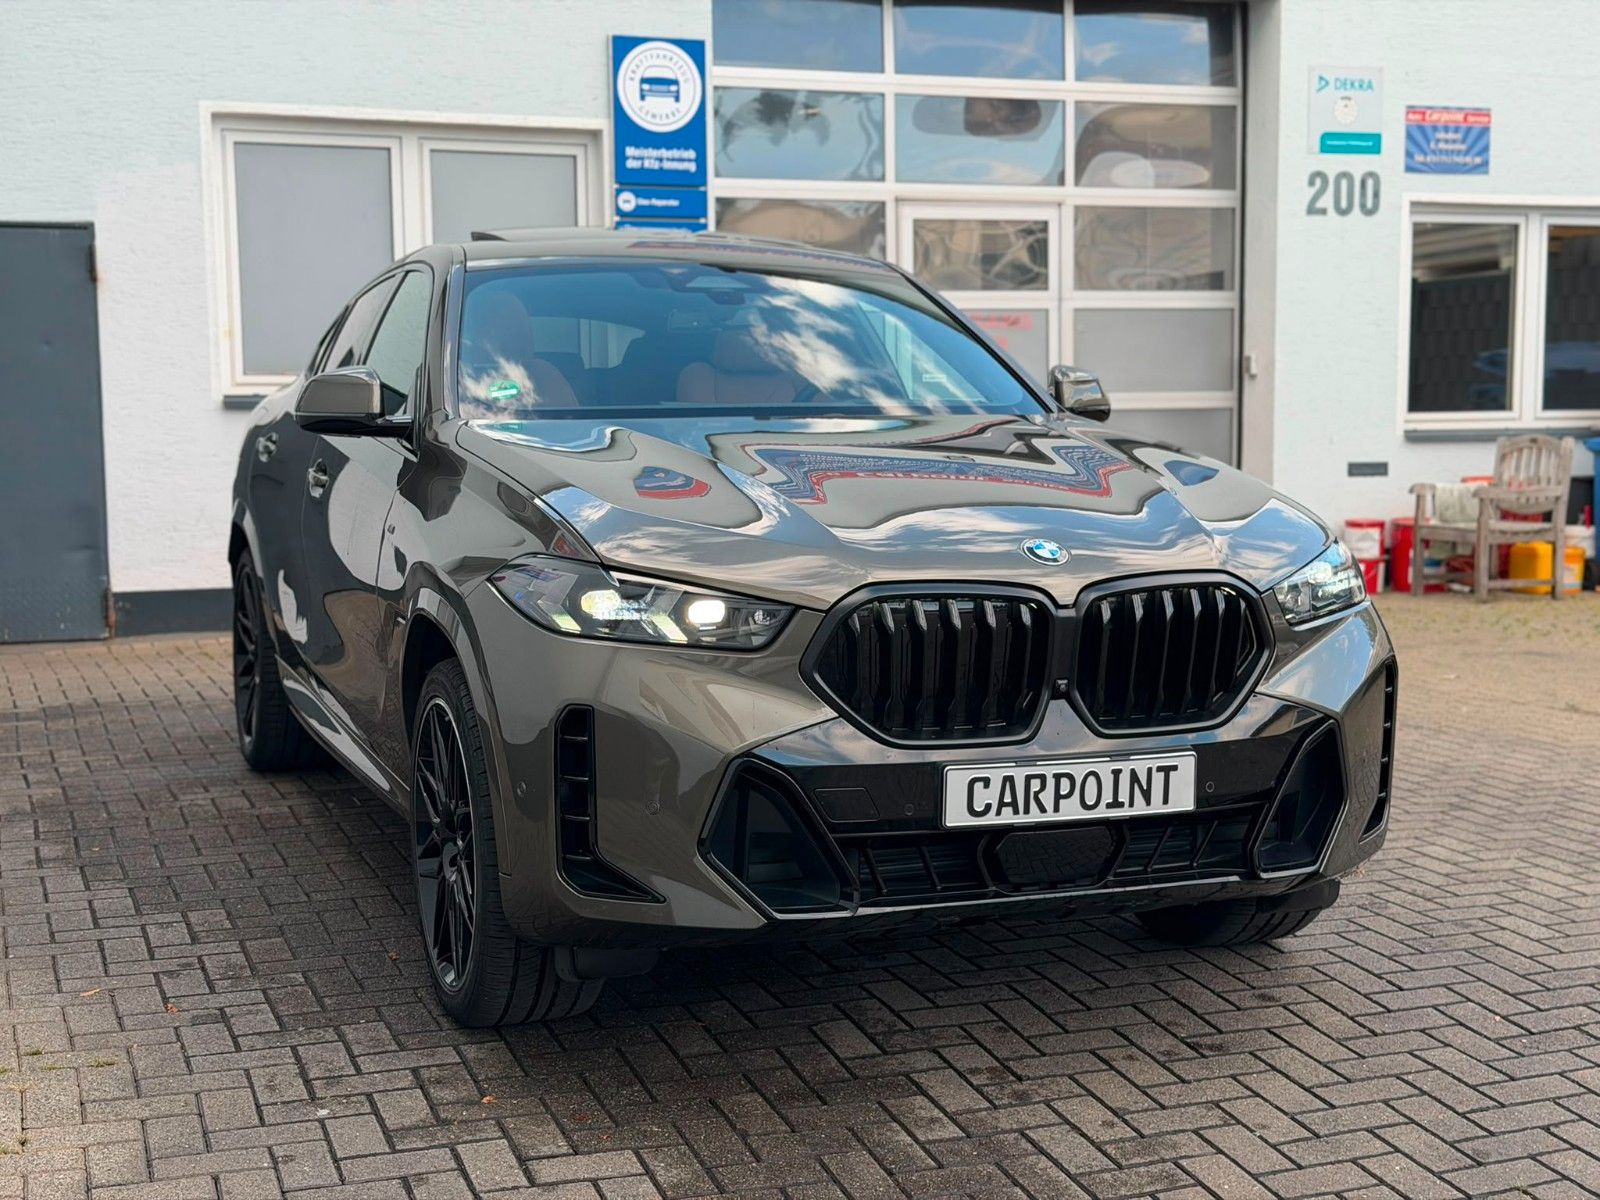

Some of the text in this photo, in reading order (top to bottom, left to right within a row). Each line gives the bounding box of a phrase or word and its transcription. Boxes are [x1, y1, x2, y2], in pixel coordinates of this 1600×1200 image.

[1334, 77, 1374, 92] DEKRA
[625, 146, 696, 160] Meisterbetrieb
[625, 159, 642, 170] der
[1306, 170, 1381, 217] 200
[966, 764, 1178, 818] CARPOINT
